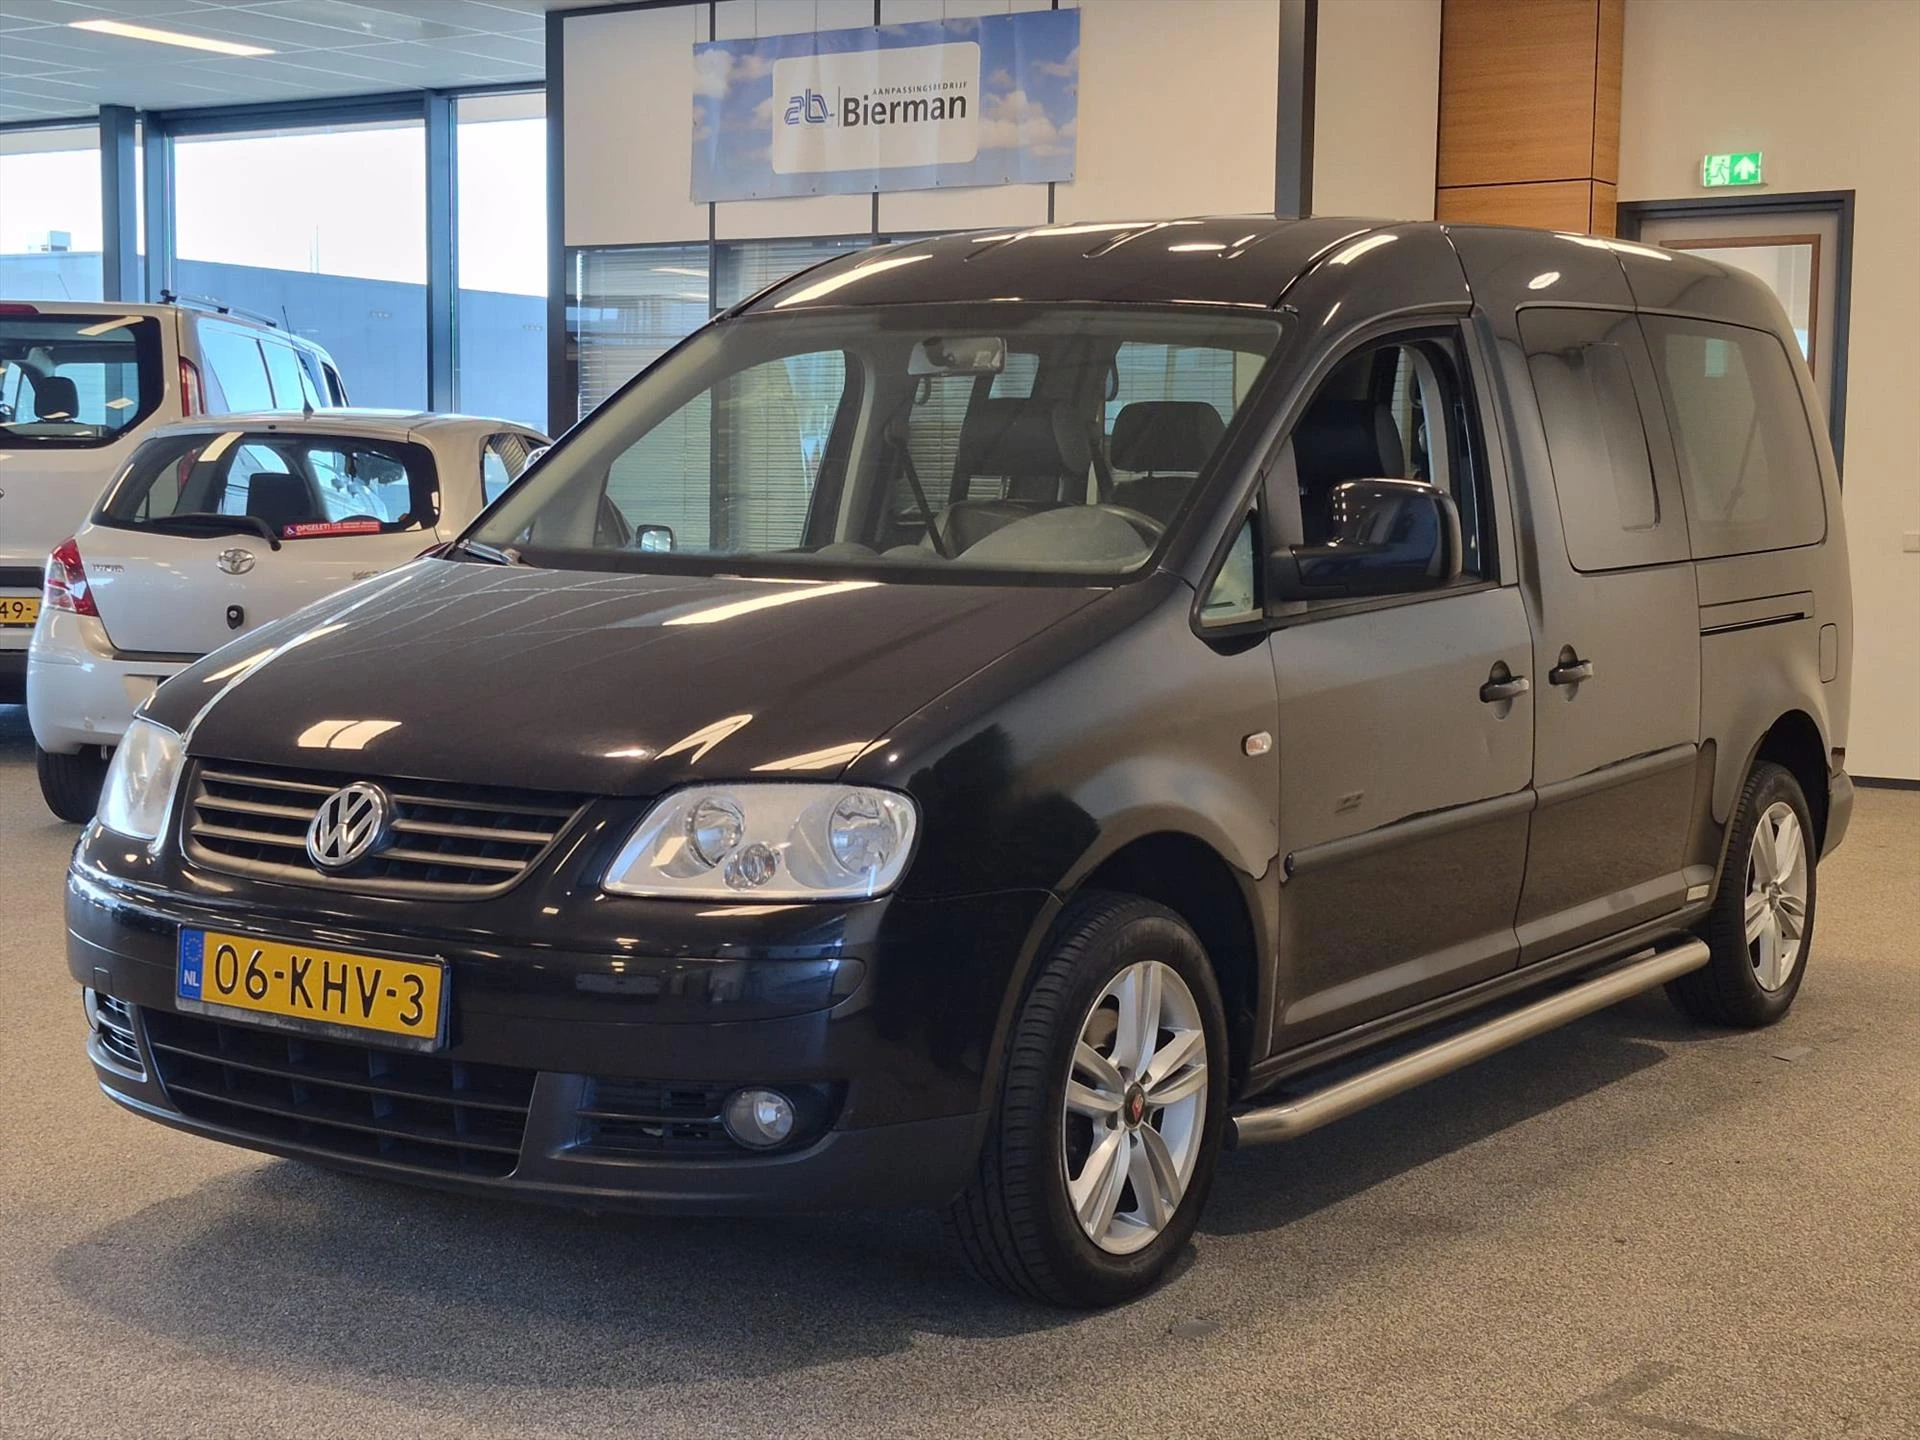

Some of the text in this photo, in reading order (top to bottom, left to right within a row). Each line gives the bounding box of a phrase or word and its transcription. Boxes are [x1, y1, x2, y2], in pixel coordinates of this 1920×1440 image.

[843, 94, 967, 127] Bierman
[0, 601, 39, 619] 49-
[183, 970, 199, 987] NL
[214, 944, 424, 1026] 06-KHV-3
